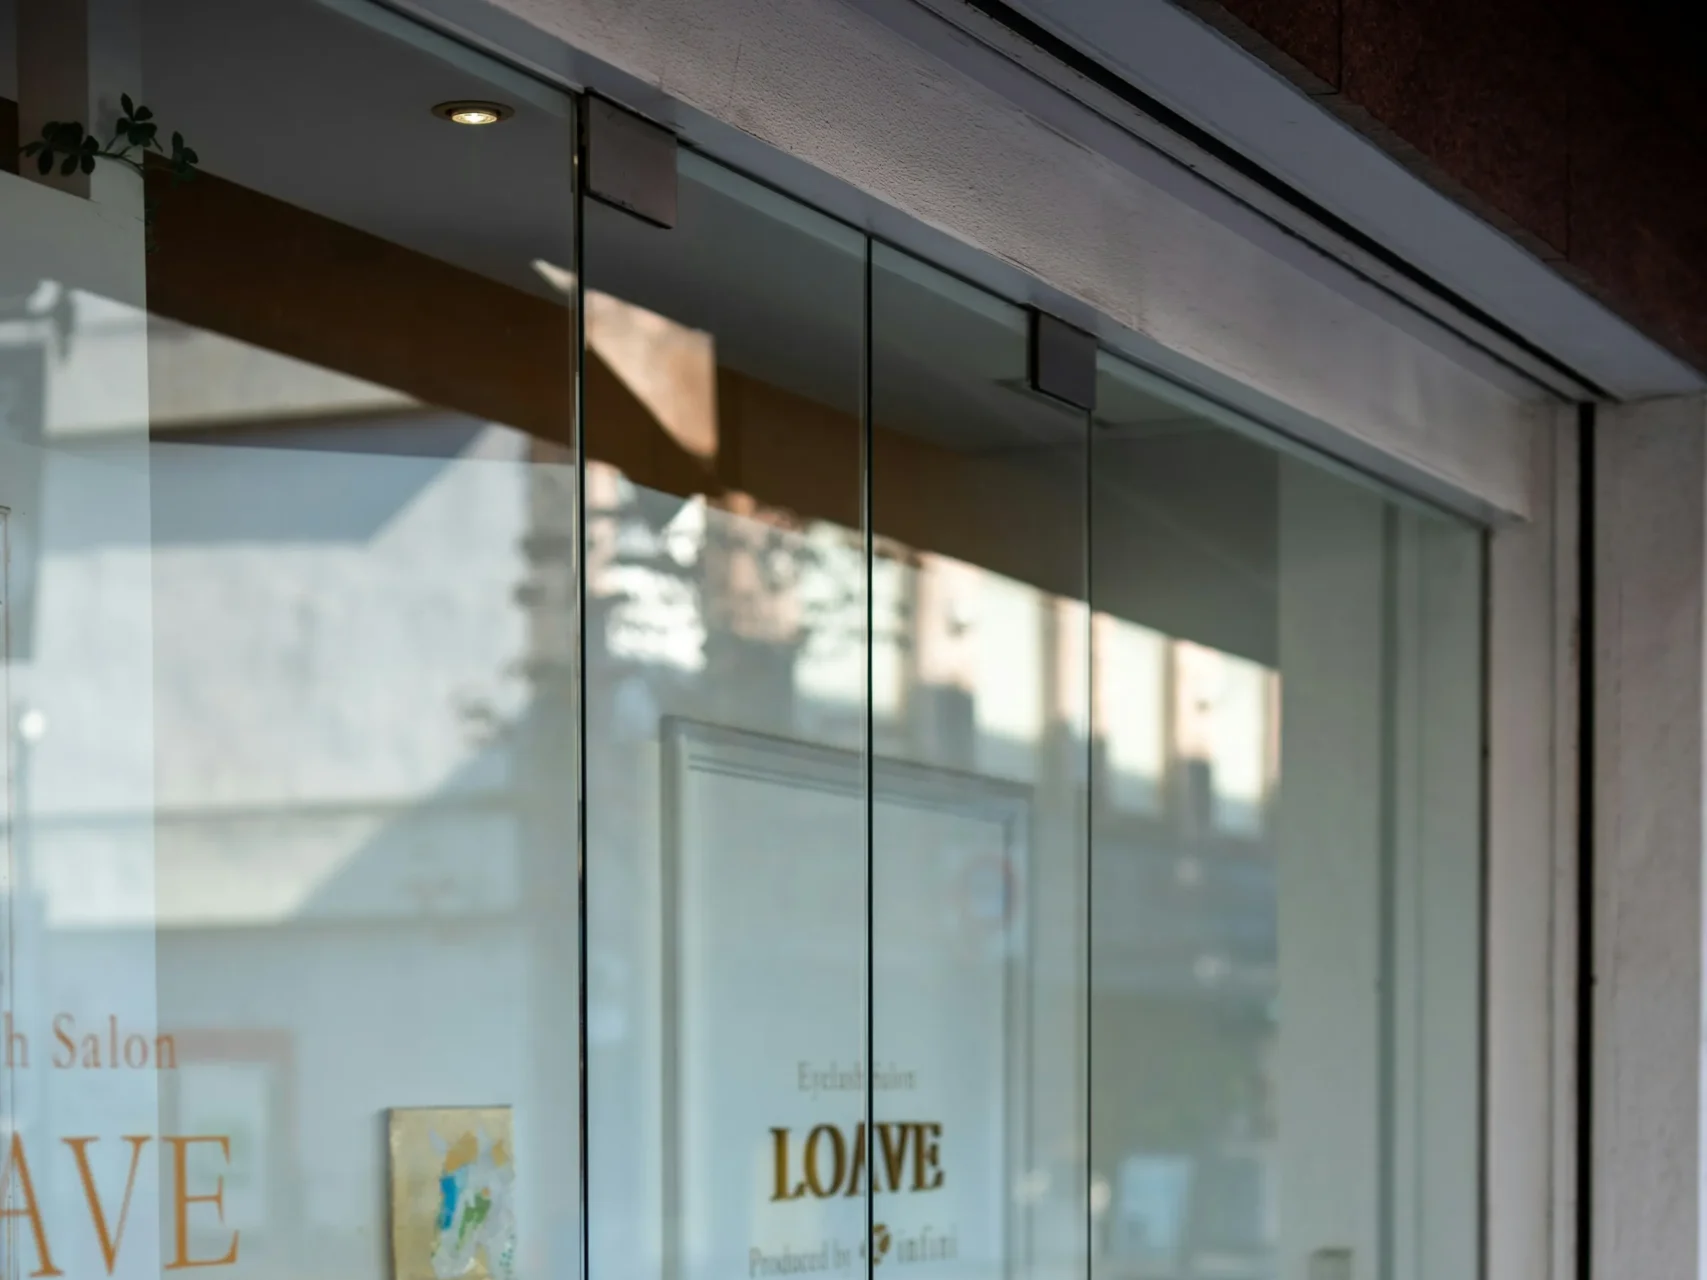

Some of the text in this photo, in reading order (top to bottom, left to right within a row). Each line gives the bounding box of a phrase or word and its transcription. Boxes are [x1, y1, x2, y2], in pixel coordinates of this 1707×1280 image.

[51, 1012, 177, 1069] Salon
[769, 1120, 945, 1202] LOAVE
[0, 1131, 240, 1279] AVE
